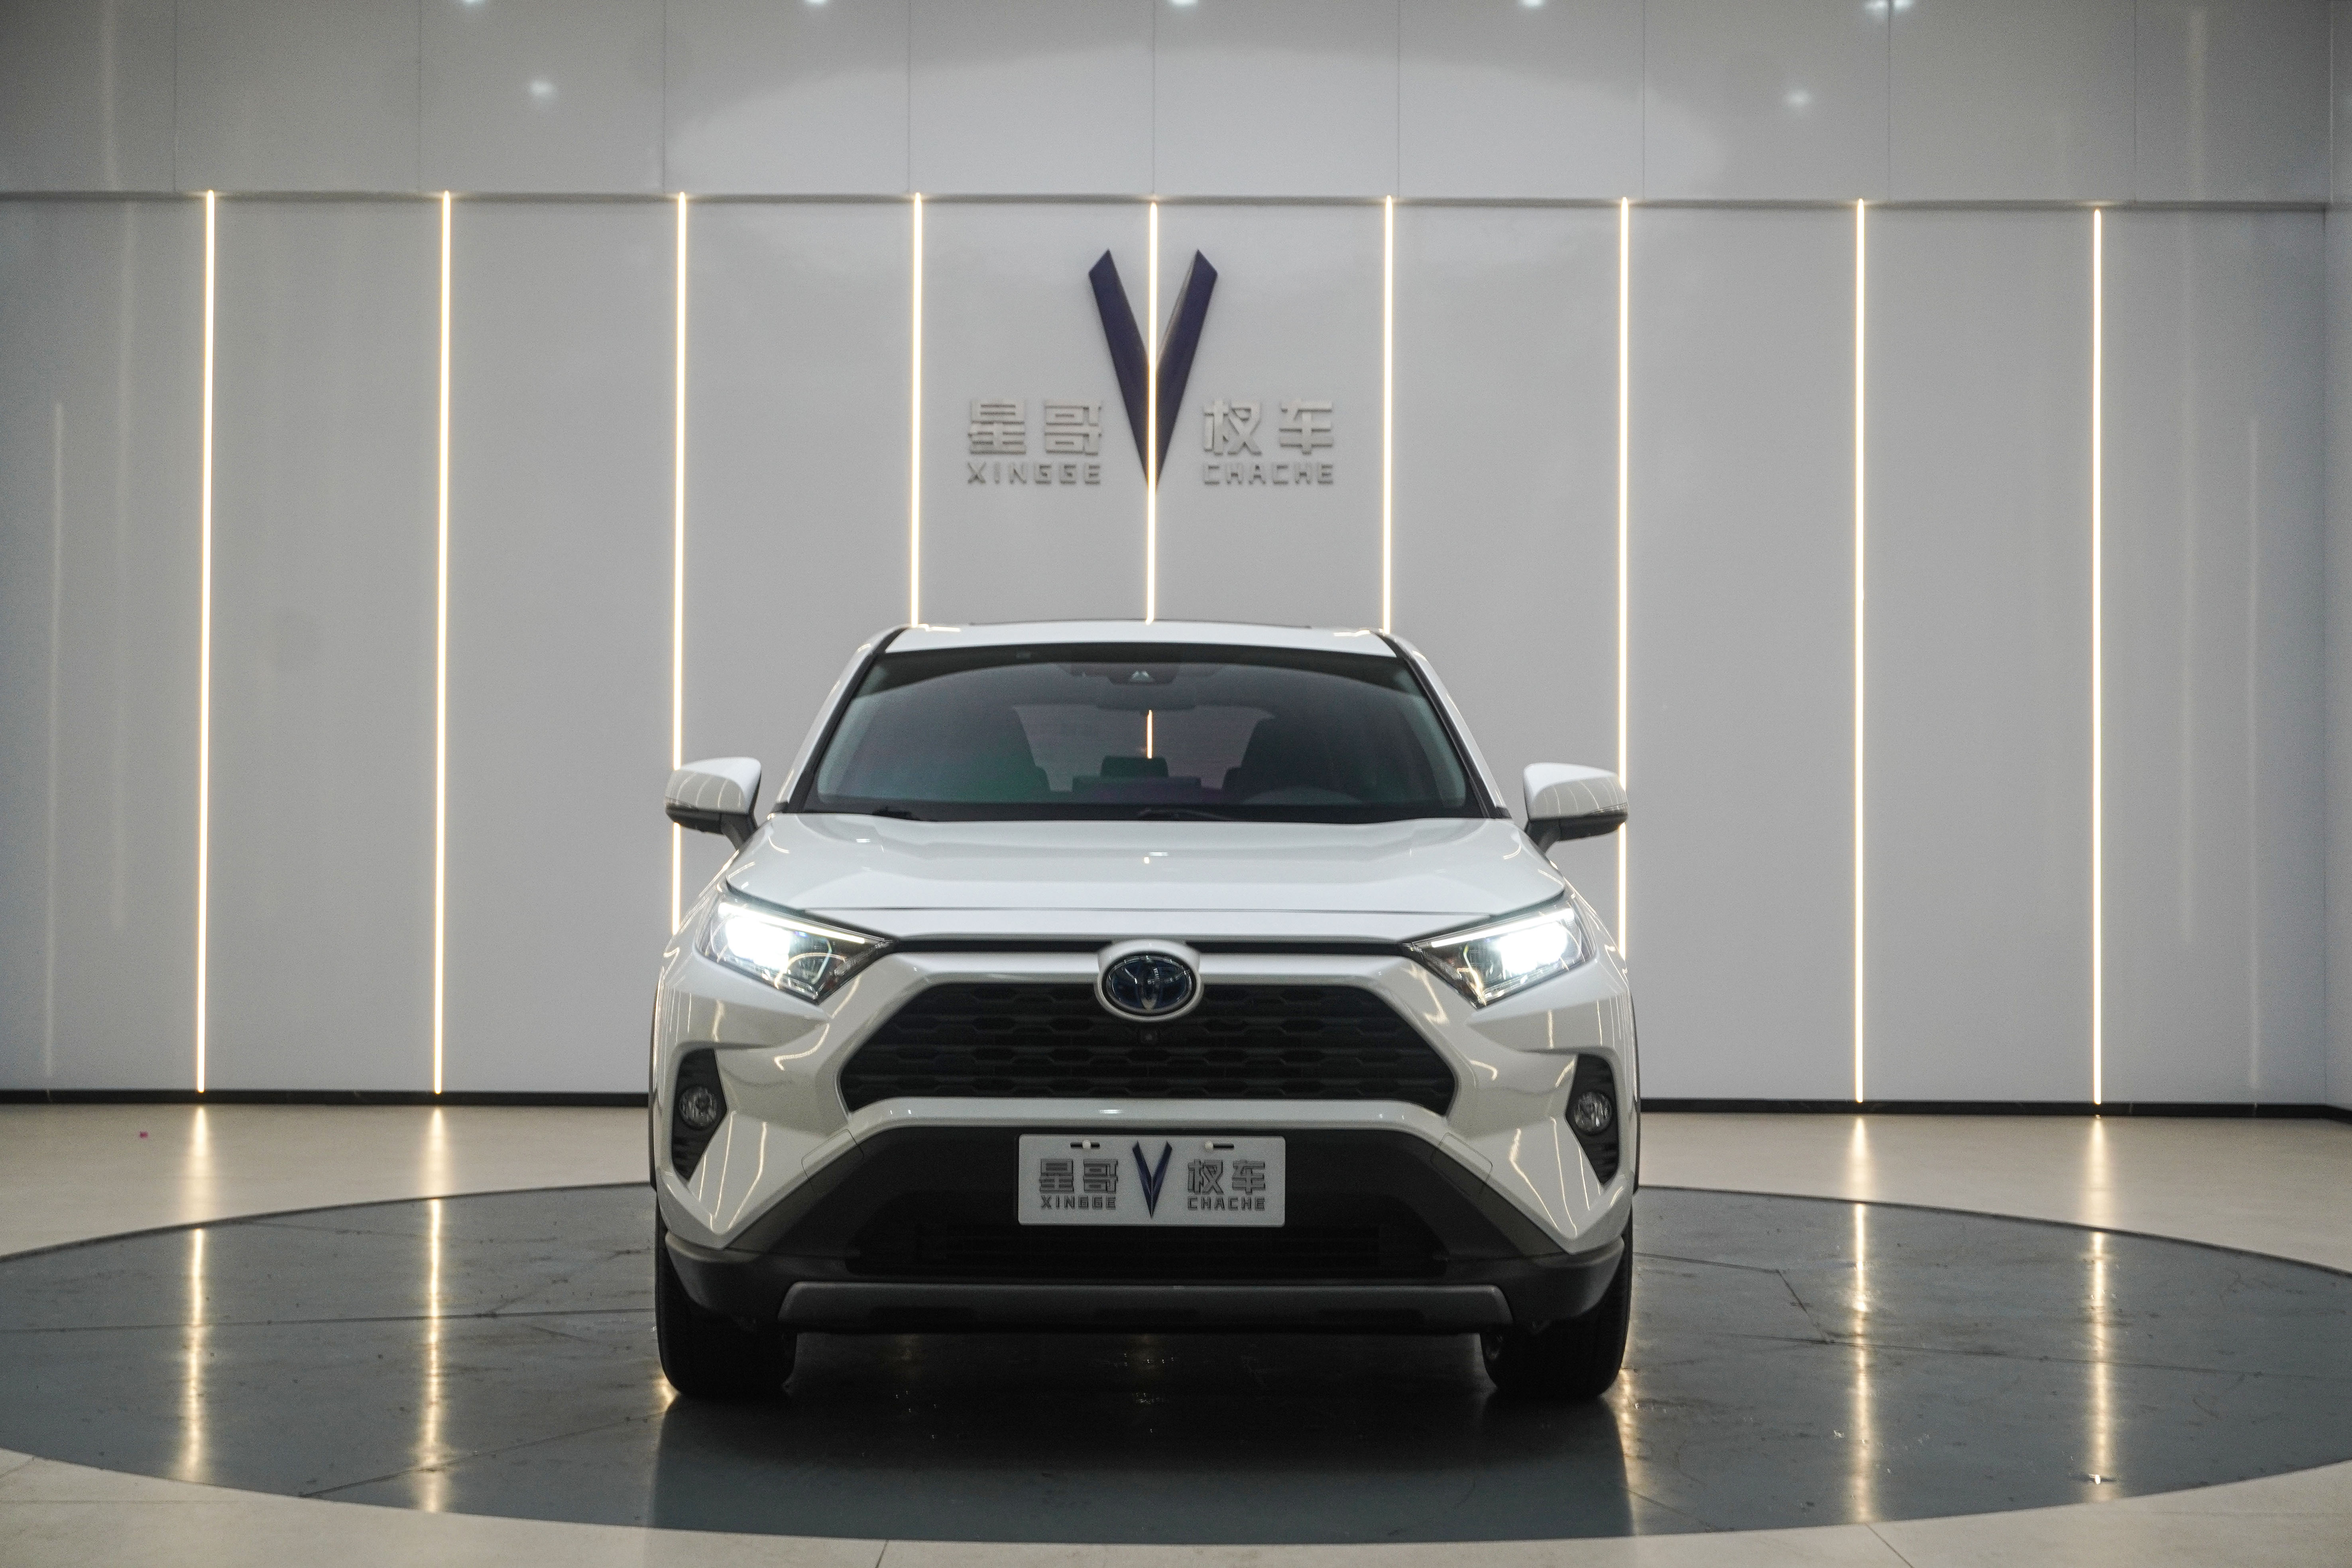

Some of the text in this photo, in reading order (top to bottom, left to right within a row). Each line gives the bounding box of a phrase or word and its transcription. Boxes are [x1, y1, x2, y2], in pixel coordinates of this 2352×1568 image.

[968, 399, 1101, 456] 星哥
[967, 461, 1334, 485] XINGGE CHACHE
[1039, 1158, 1118, 1193] 星哥
[1040, 1195, 1265, 1210] XINGGE CHACHE
